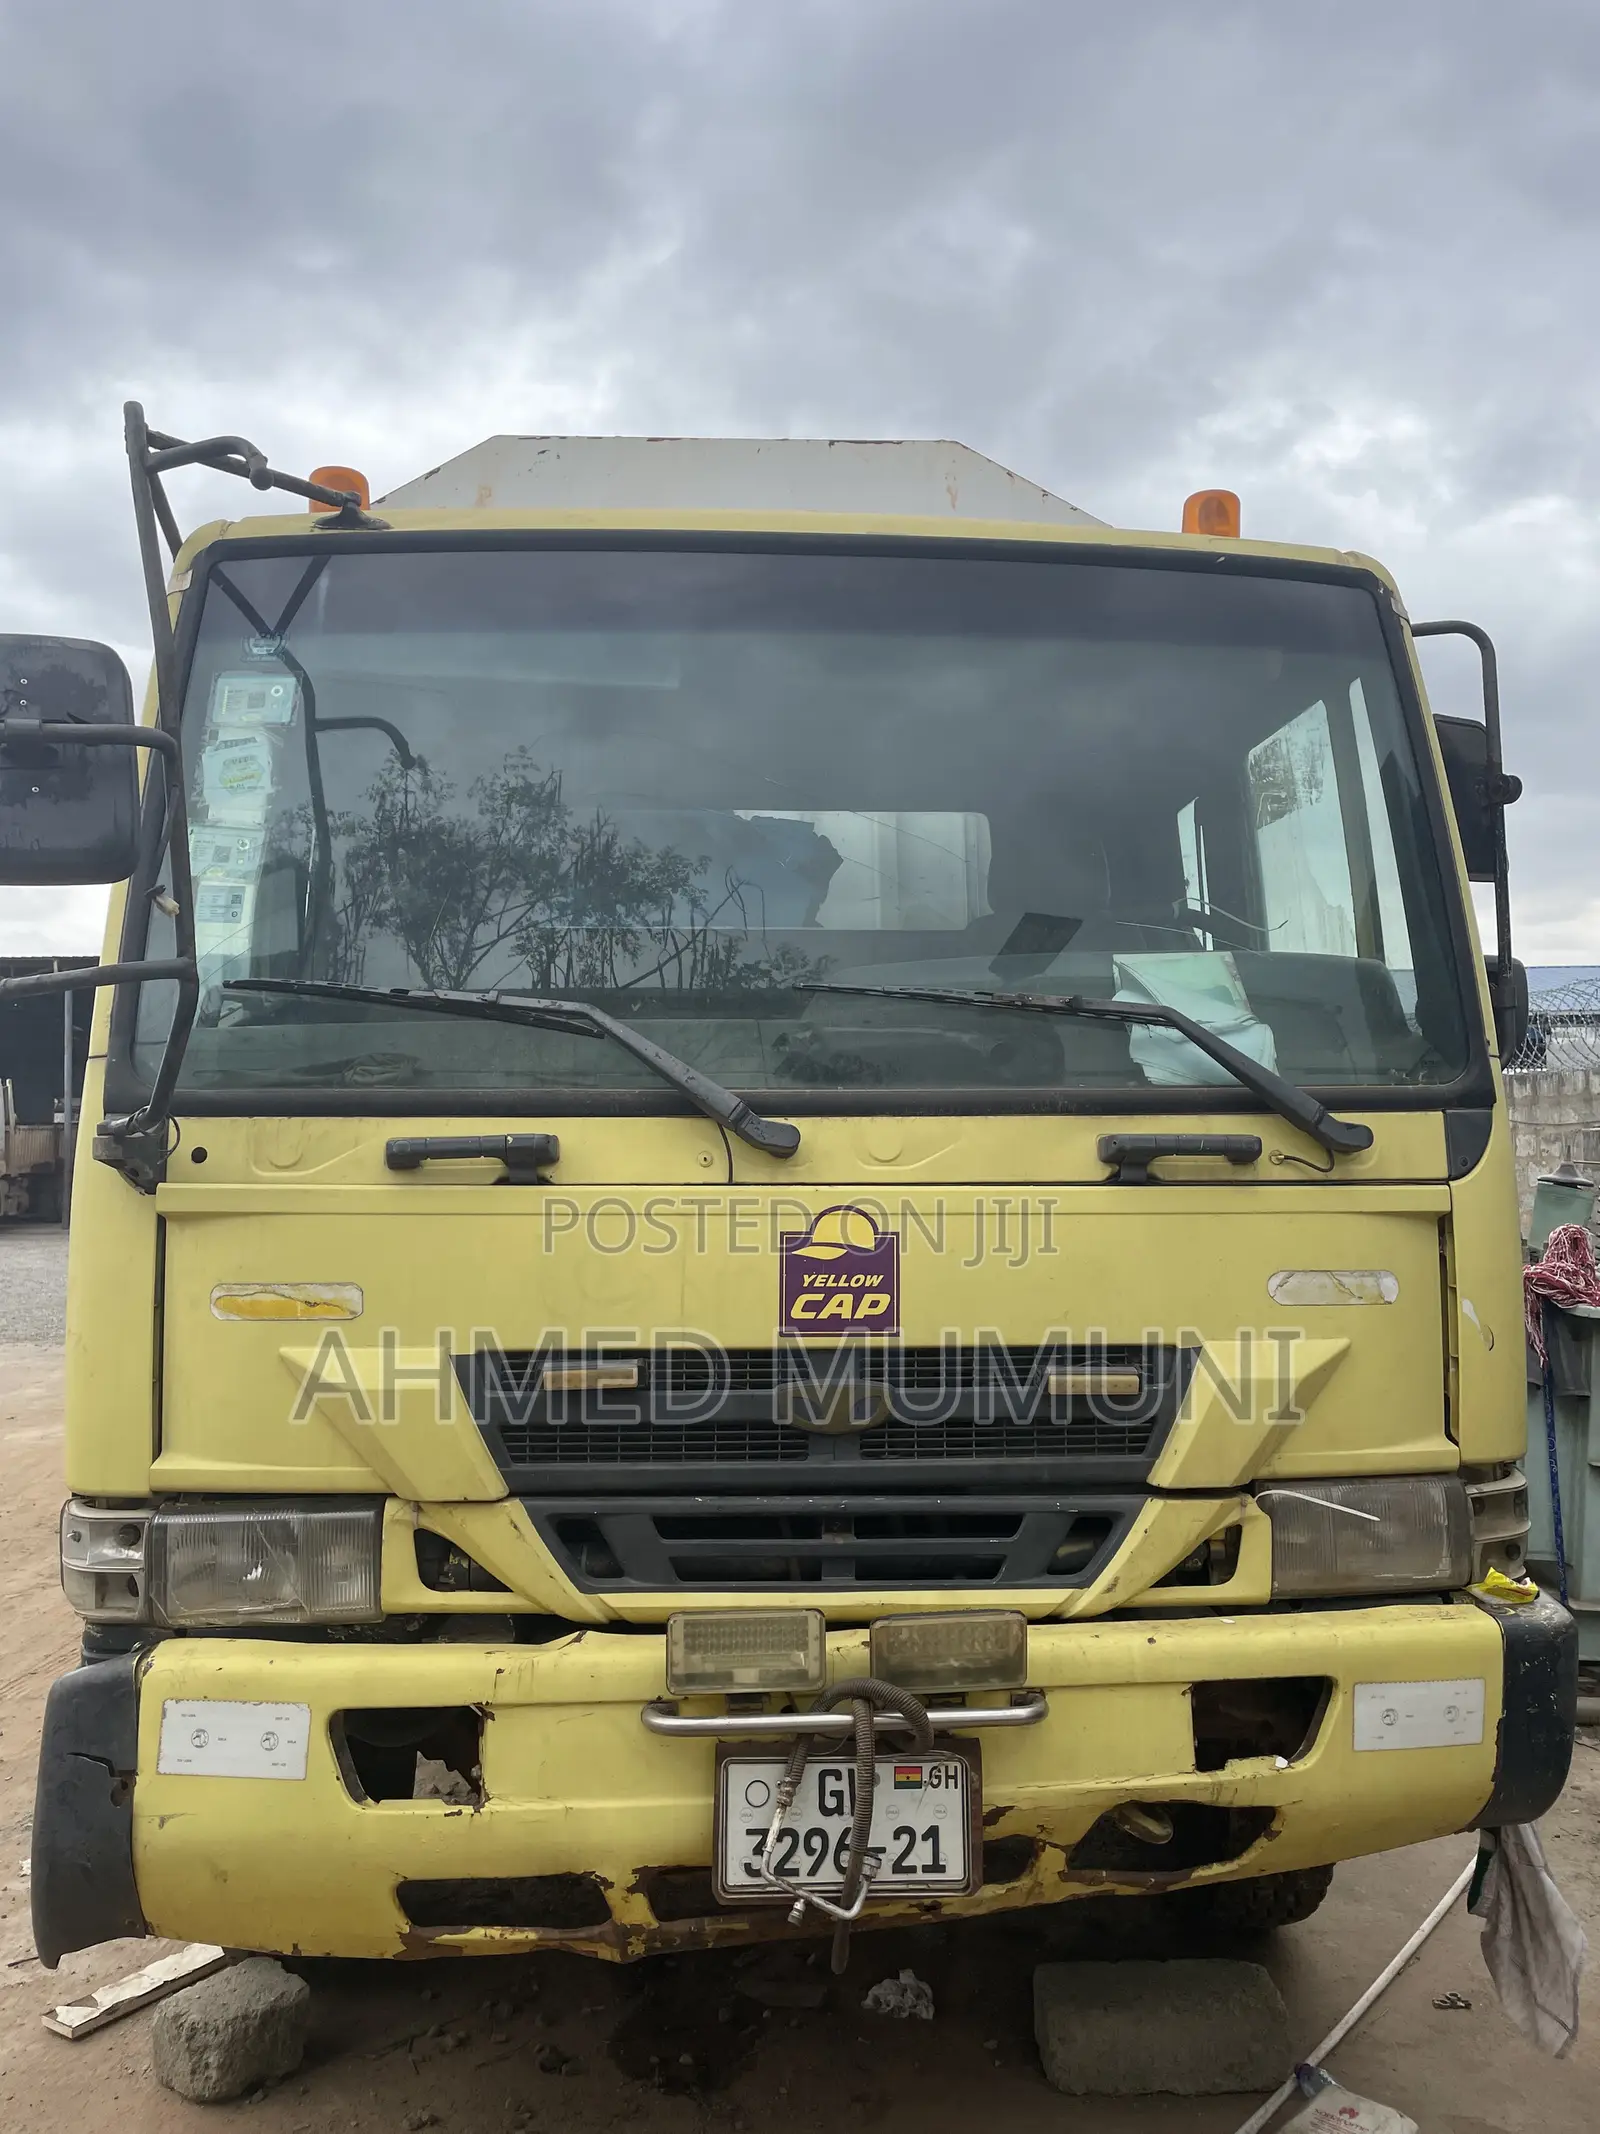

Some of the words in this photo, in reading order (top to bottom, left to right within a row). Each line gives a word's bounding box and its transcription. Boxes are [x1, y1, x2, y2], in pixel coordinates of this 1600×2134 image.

[803, 1274, 884, 1288] YELLOW
[790, 1293, 891, 1319] CAP
[929, 1764, 959, 1789] GH
[818, 1768, 858, 1817] G
